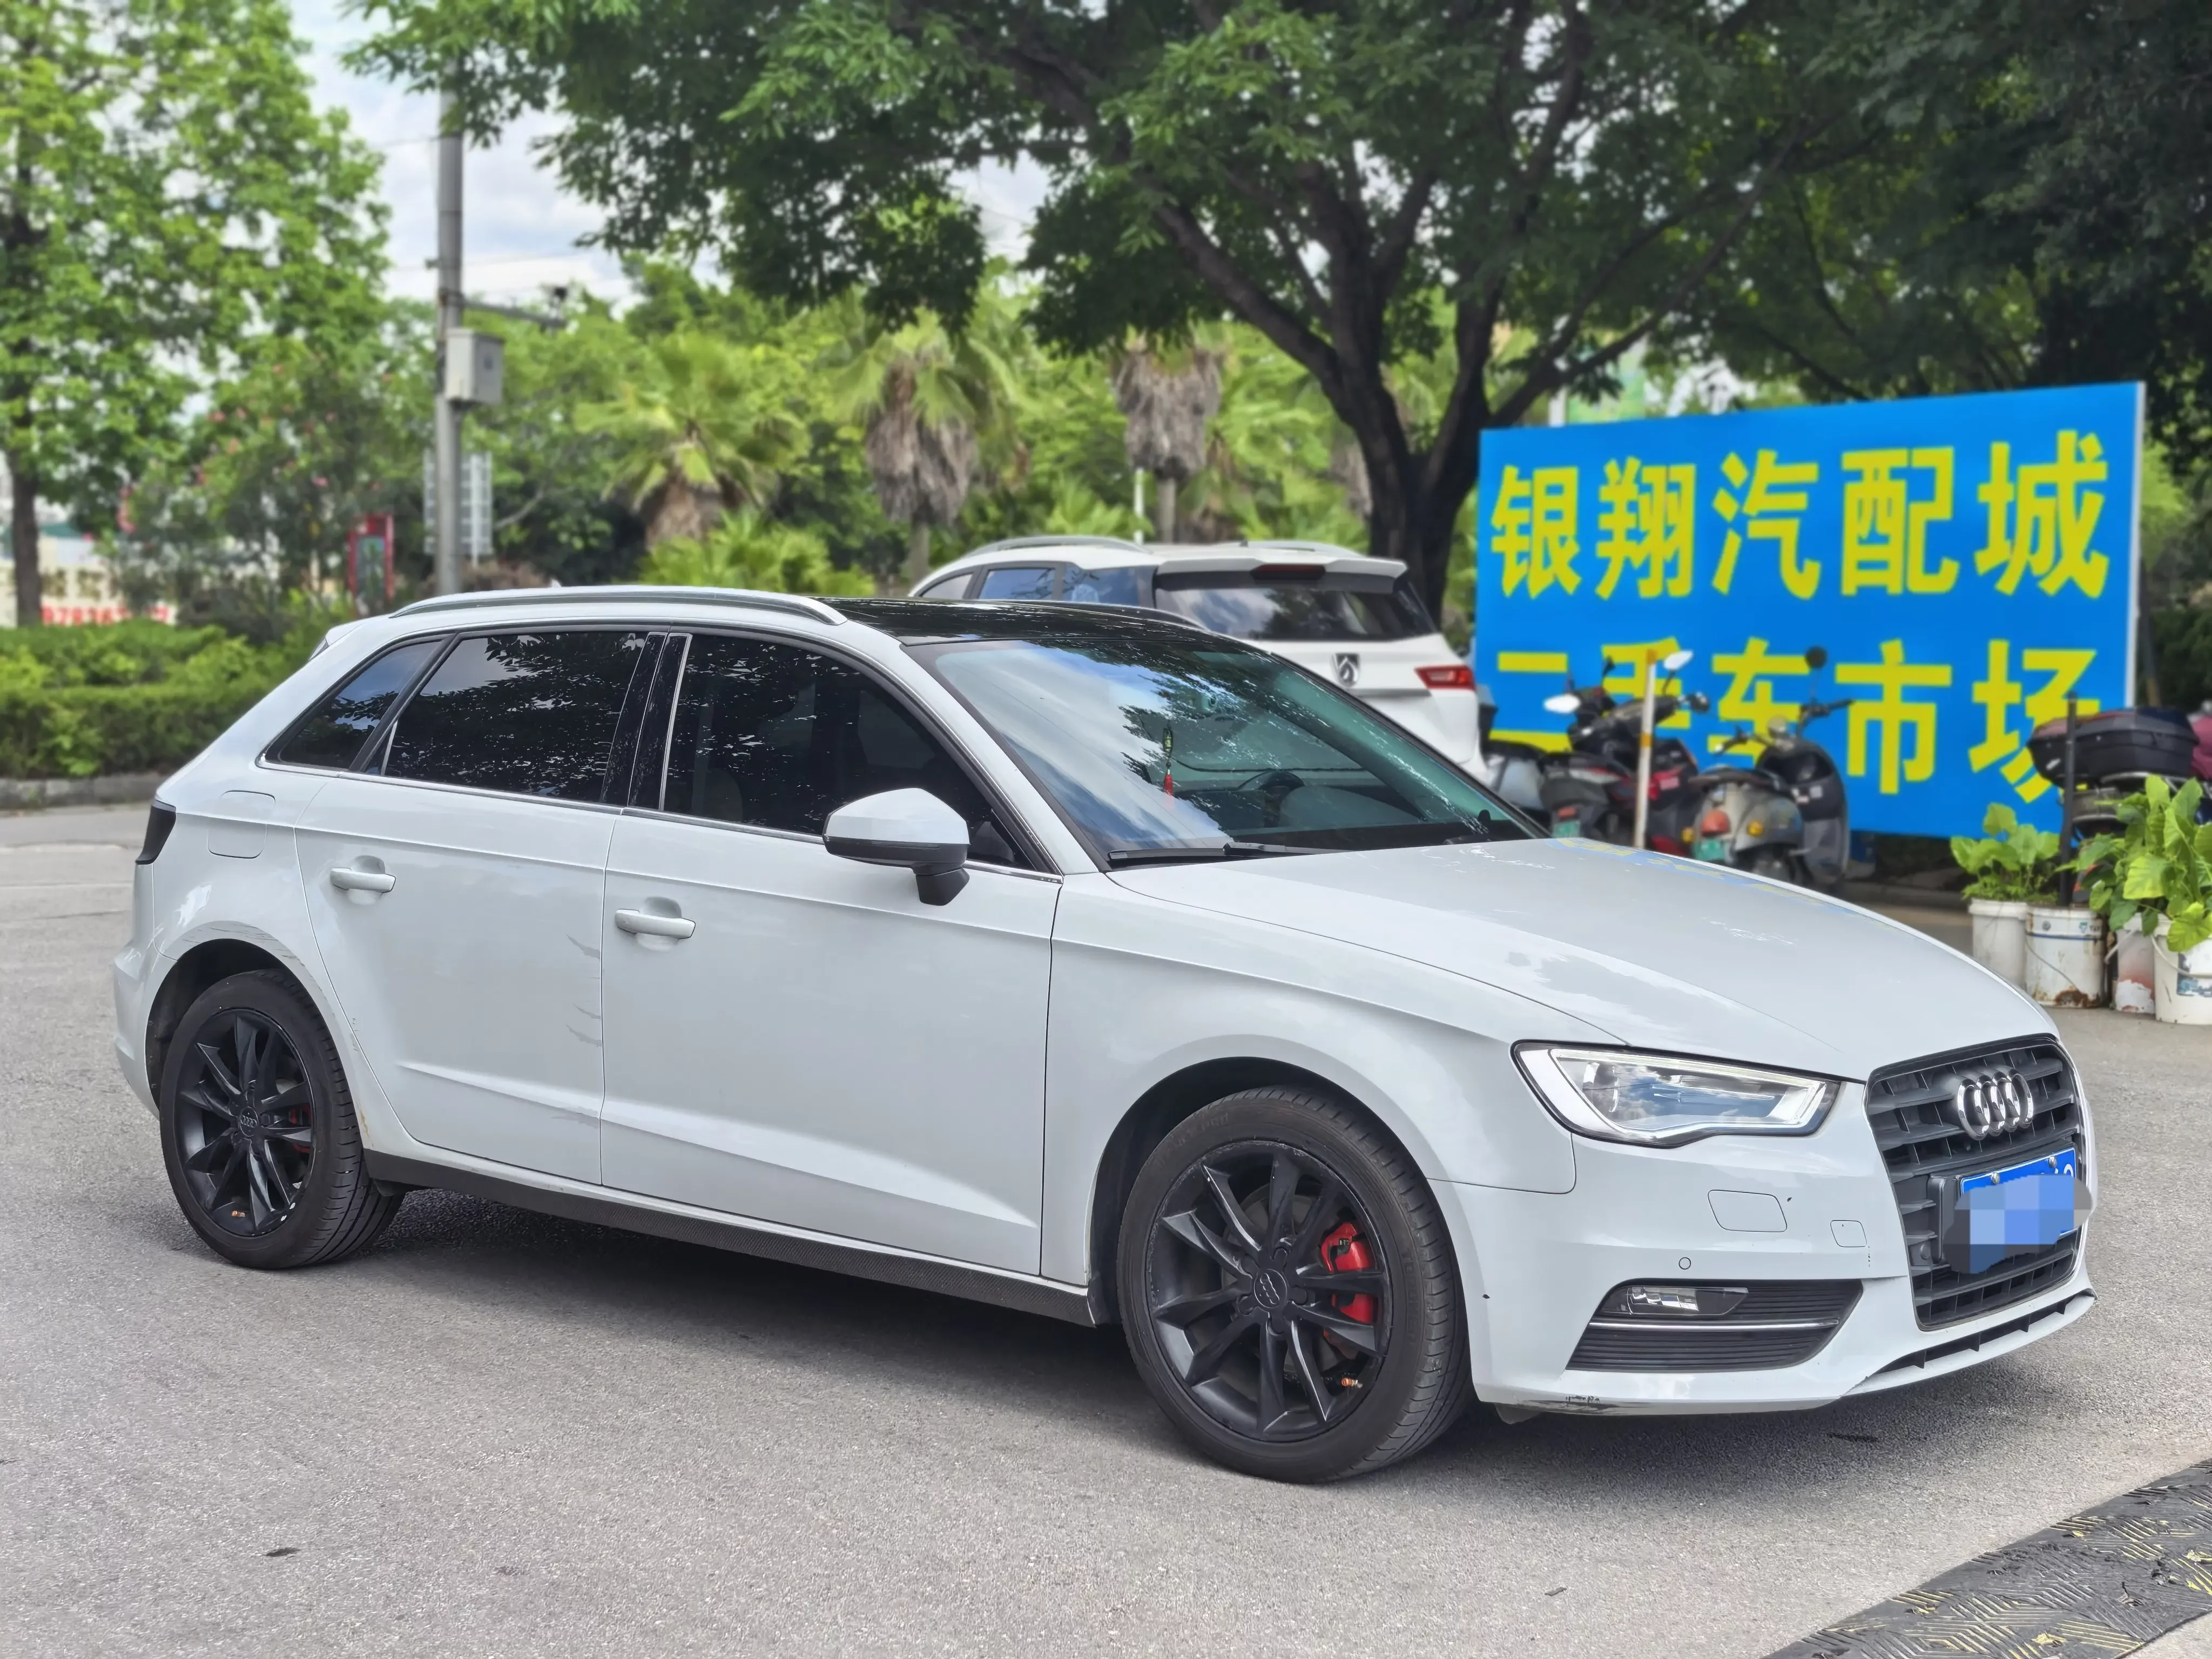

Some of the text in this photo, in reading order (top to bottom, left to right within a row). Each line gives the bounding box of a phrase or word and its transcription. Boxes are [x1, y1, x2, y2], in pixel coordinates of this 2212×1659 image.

[1491, 430, 2109, 599] 银翔汽配城
